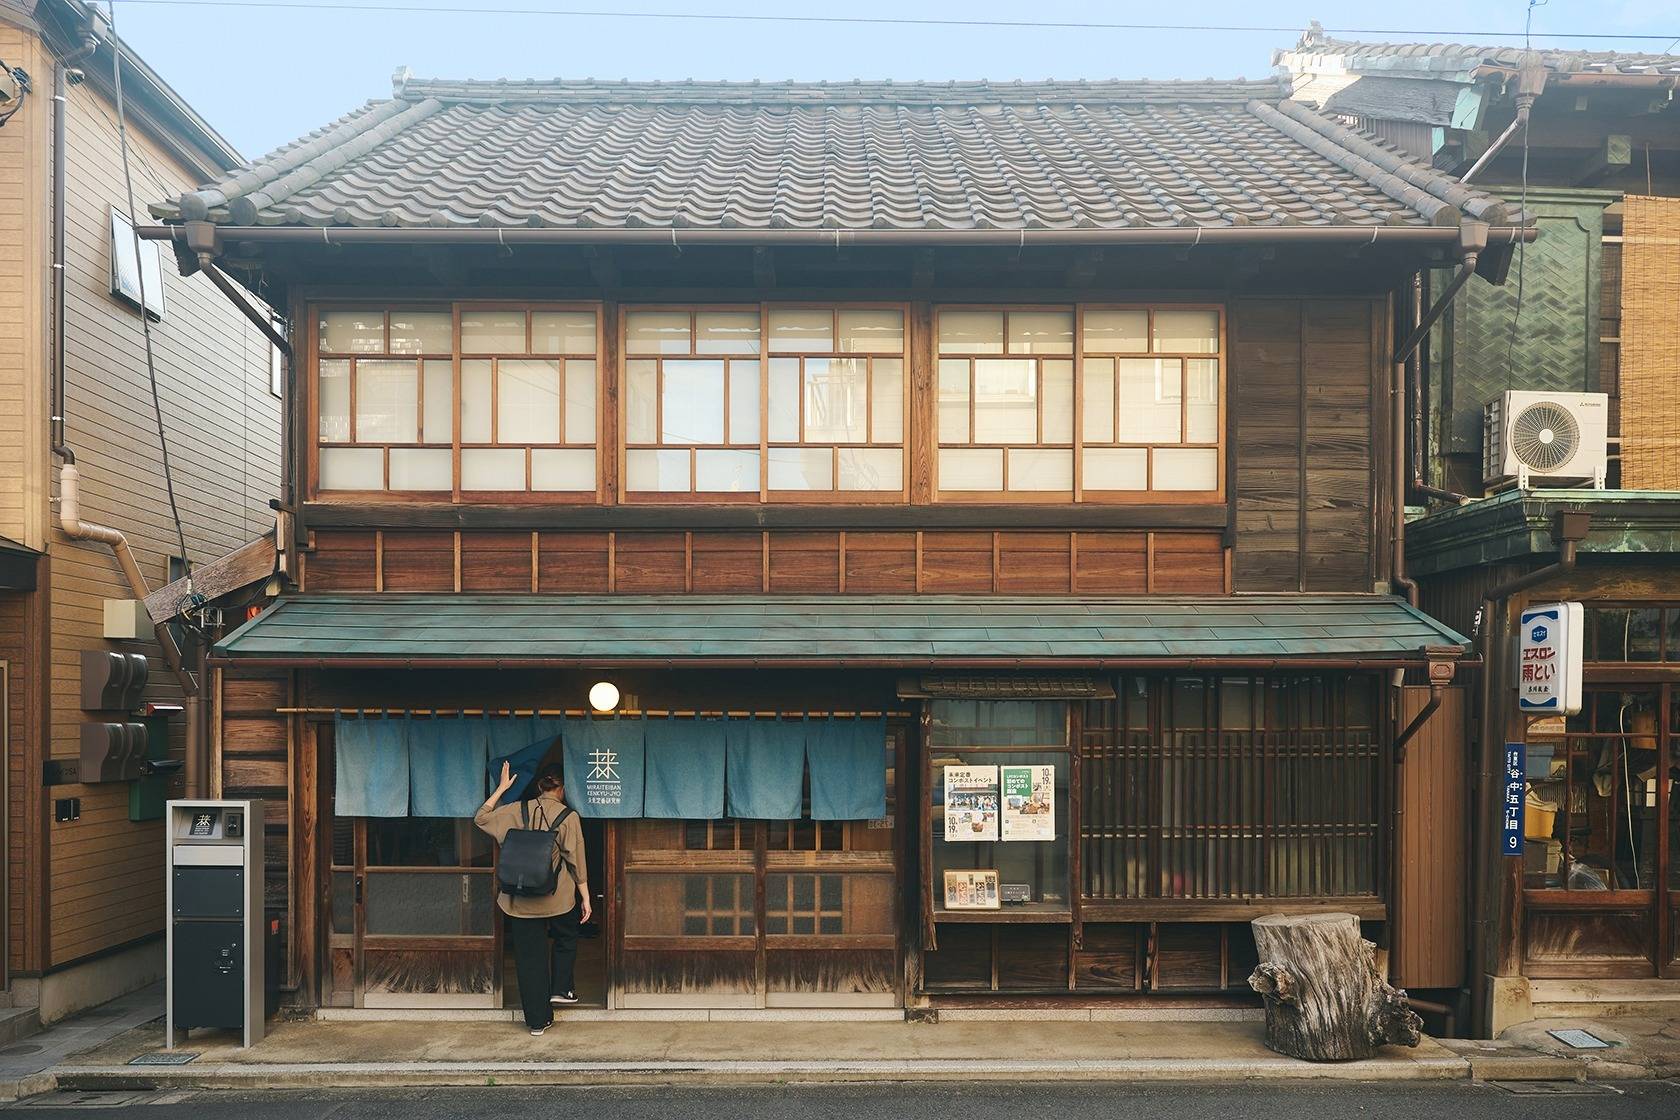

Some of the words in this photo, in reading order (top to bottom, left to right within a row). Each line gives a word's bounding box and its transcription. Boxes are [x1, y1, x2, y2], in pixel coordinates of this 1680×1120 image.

[1523, 646, 1556, 661] エスロン
[1522, 663, 1556, 682] 雨とい
[1509, 768, 1520, 830] 谷中五丁目
[1509, 836, 1517, 849] 9
